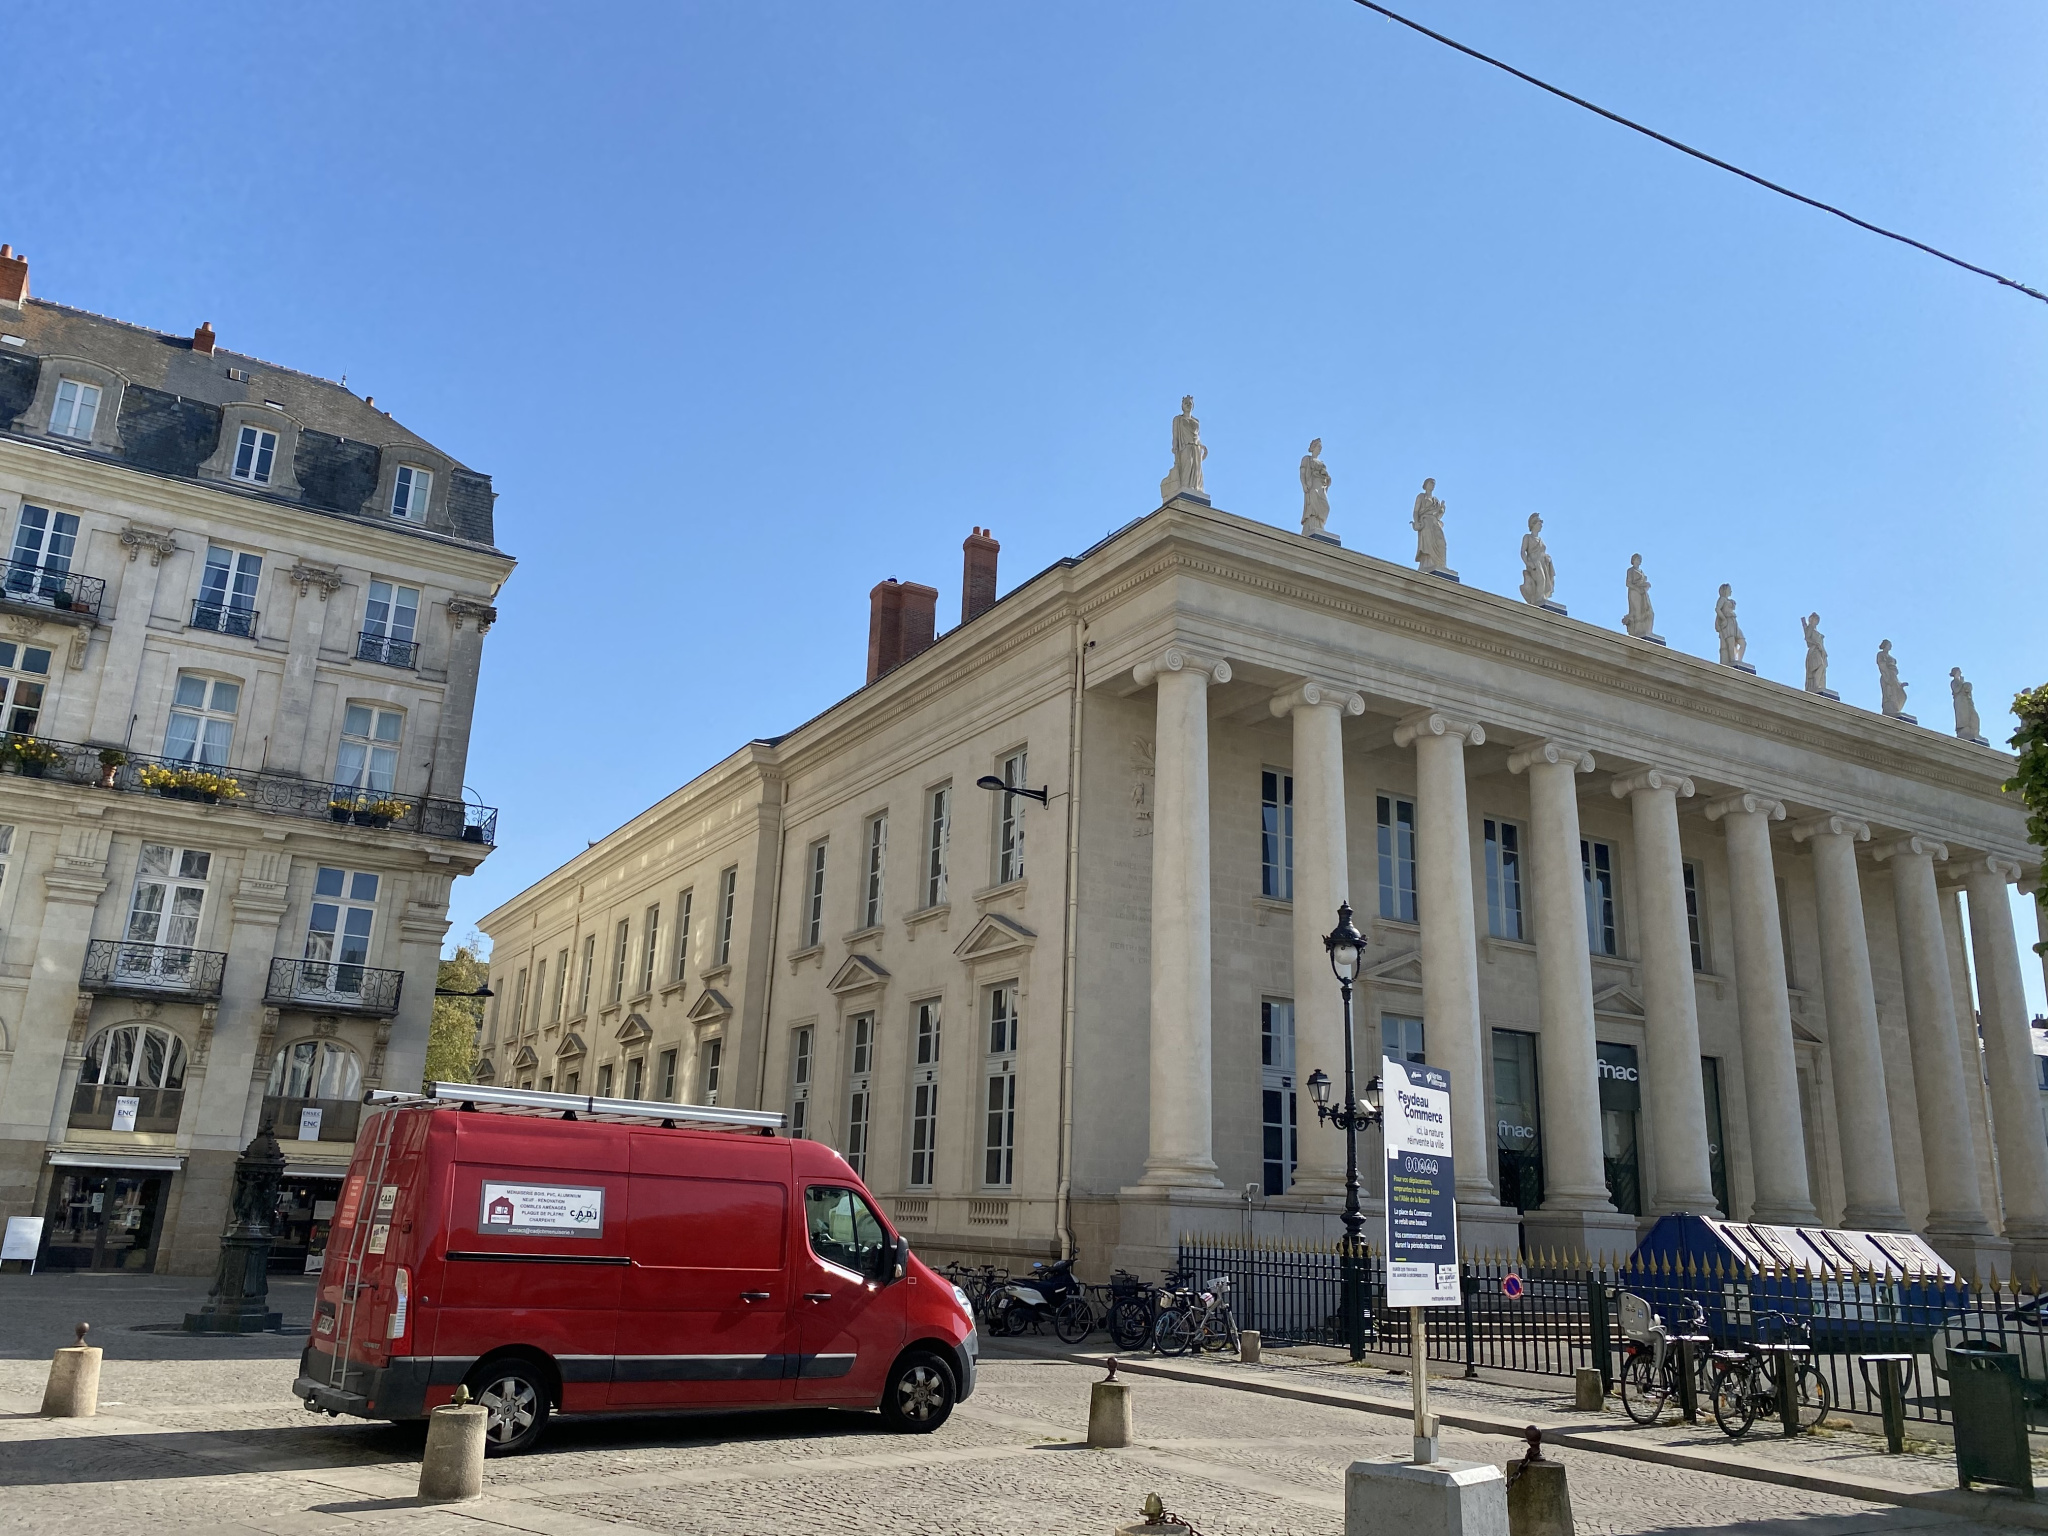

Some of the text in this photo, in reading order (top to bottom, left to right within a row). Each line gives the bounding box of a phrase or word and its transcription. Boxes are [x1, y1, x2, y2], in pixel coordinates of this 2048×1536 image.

[1597, 1059, 1638, 1081] fnac
[1398, 1090, 1429, 1108] Feydeau
[1404, 1105, 1443, 1124] Commerce
[1429, 1128, 1444, 1138] nature
[1498, 1120, 1534, 1138] fnac
[1435, 1140, 1444, 1150] ville
